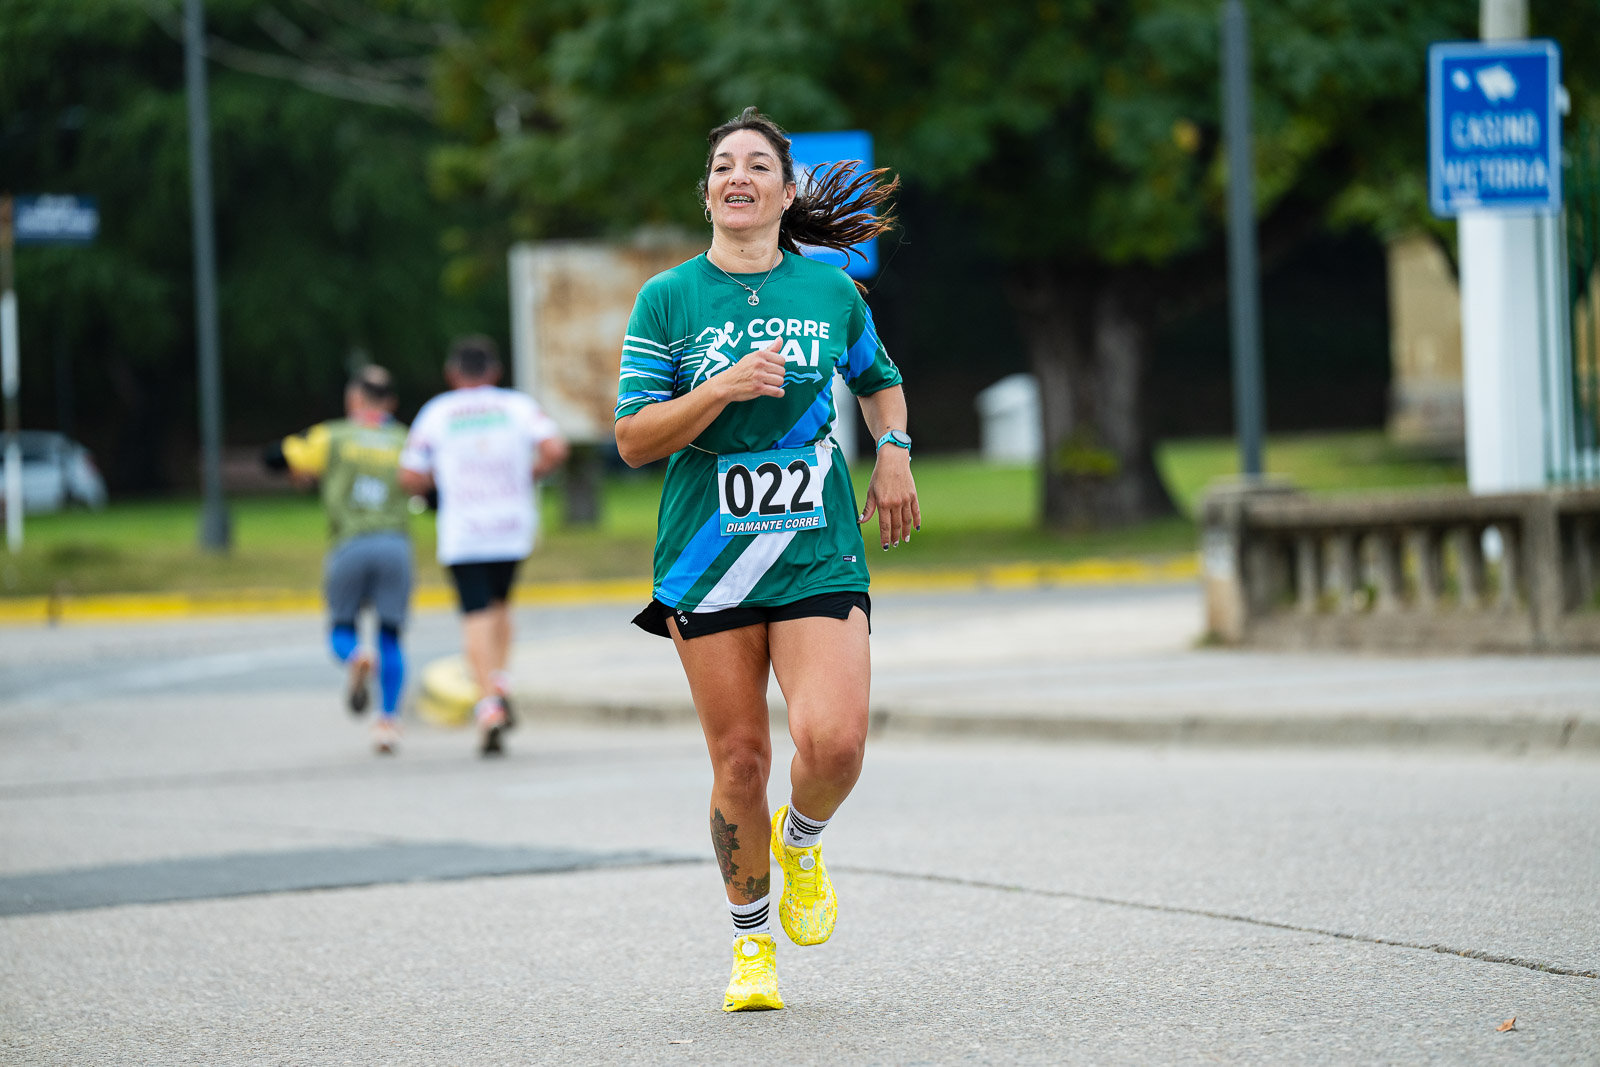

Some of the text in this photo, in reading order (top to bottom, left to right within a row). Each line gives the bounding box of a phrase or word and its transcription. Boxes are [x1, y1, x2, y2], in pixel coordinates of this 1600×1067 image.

[747, 317, 831, 340] CORRE
[725, 459, 815, 519] 022
[726, 516, 820, 533] DIAMANTE CORRE
